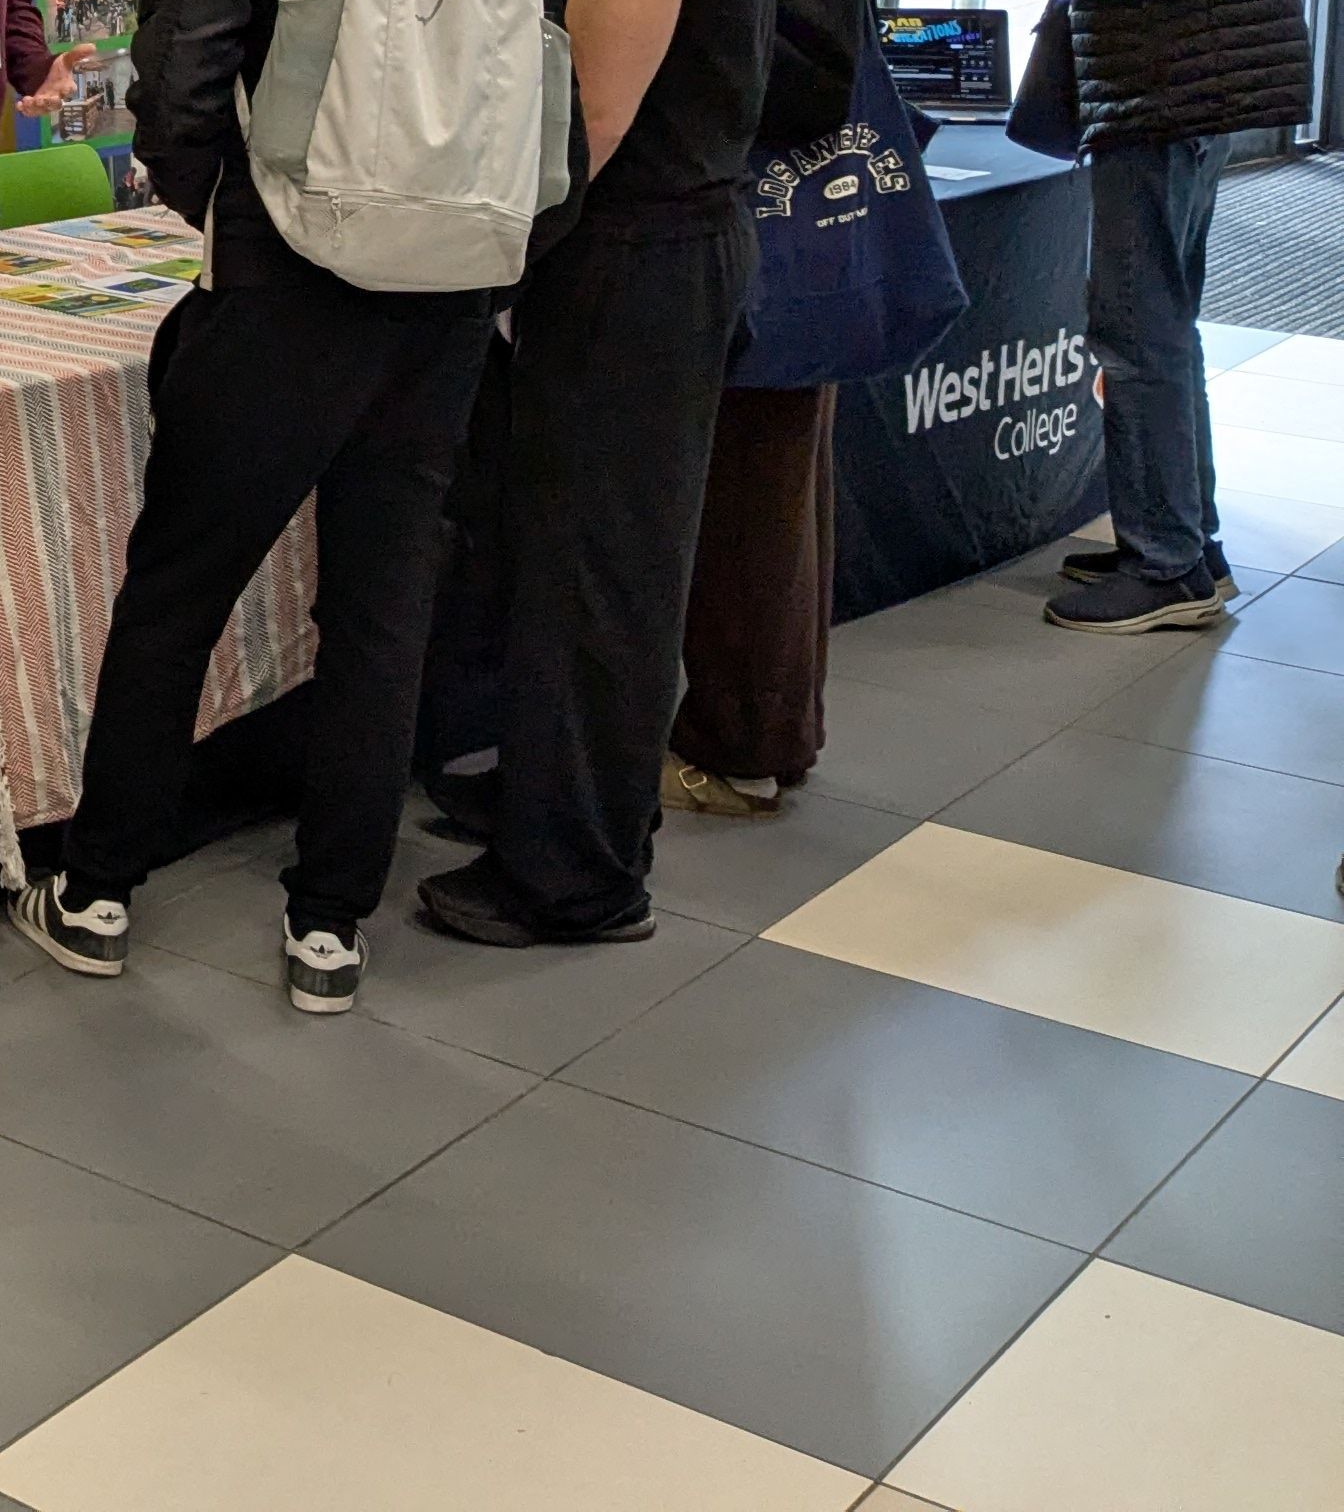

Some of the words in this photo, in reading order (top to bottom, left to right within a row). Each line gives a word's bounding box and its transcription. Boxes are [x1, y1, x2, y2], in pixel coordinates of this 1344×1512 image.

[756, 160, 801, 219] LOS
[904, 342, 997, 435] West
[997, 326, 1086, 406] Herts
[994, 401, 1077, 461] College
